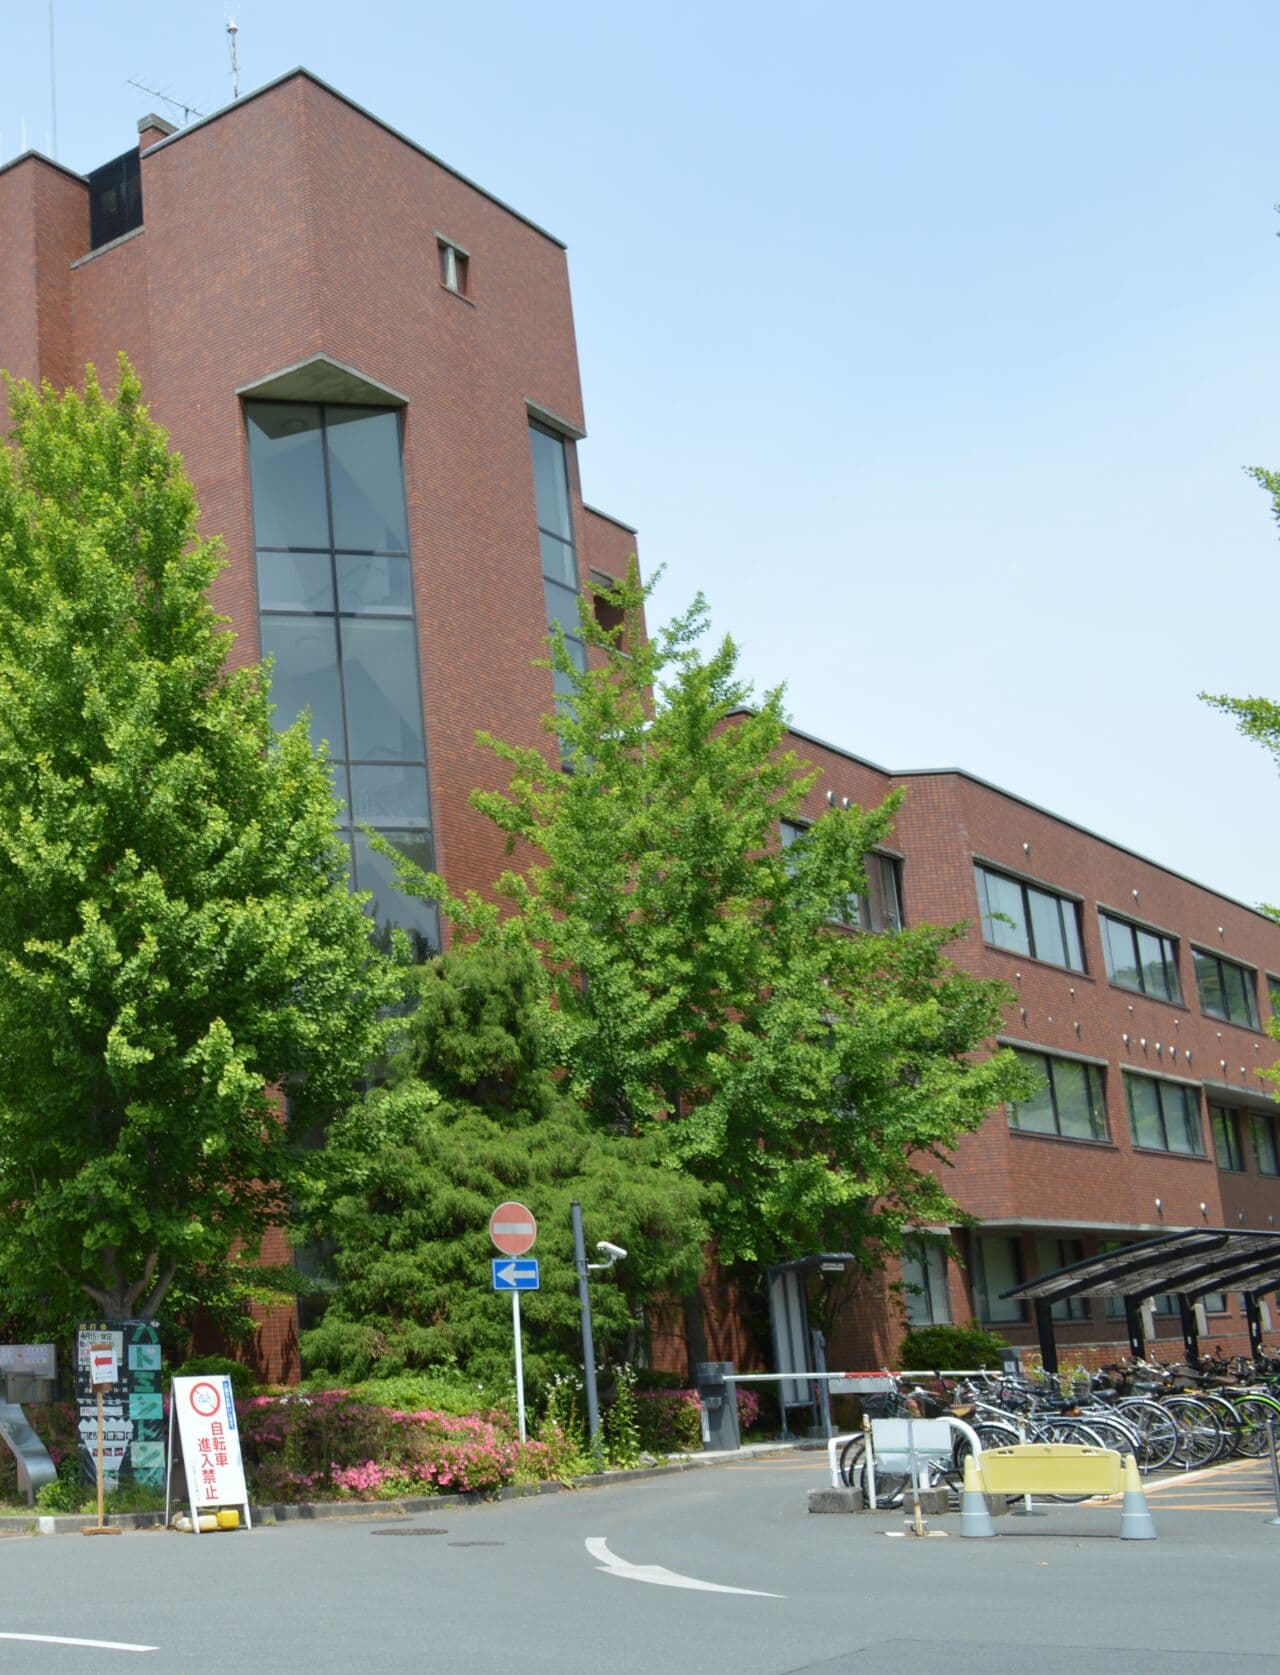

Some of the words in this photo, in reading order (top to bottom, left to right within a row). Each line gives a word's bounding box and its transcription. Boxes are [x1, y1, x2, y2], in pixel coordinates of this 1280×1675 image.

[197, 1438, 219, 1500] 進入禁止
[211, 1421, 229, 1467] 自転車
